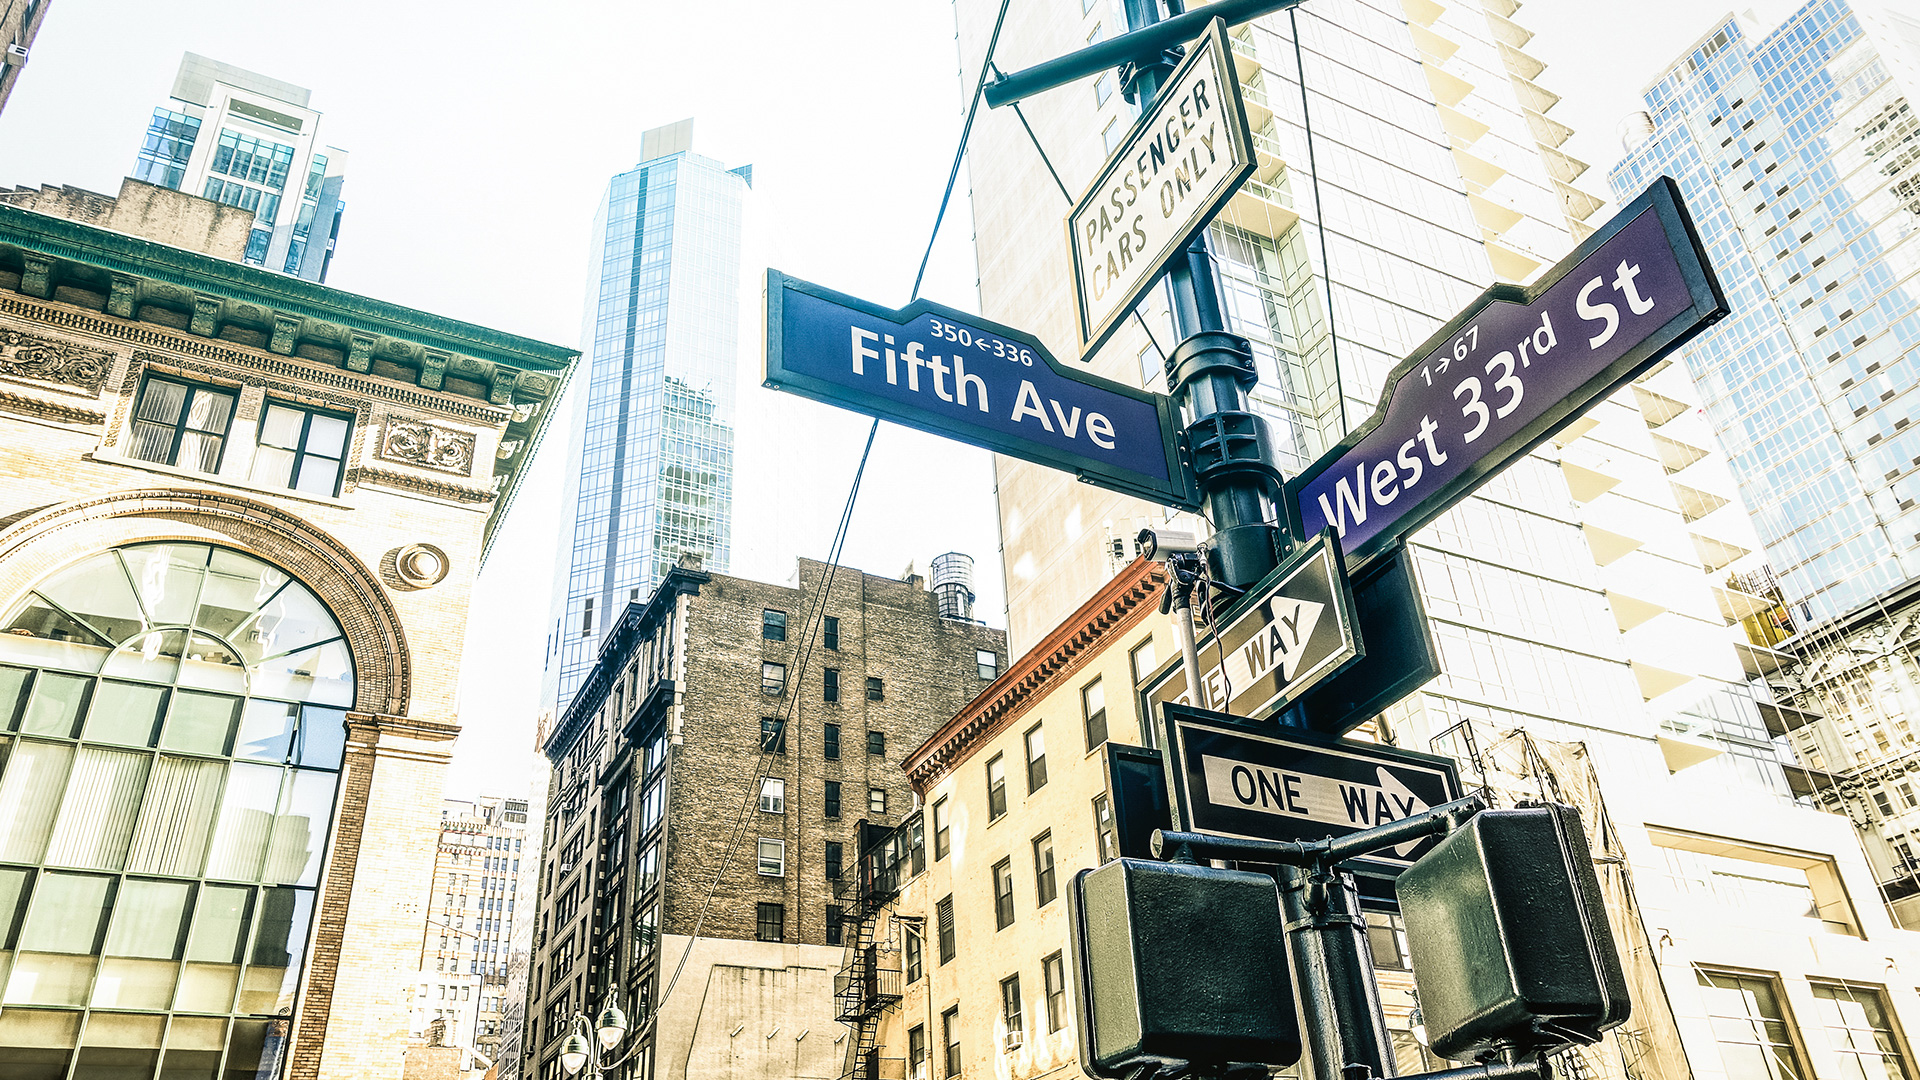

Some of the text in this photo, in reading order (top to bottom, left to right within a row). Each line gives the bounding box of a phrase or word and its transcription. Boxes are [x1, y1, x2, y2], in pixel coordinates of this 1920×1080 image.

[1086, 78, 1210, 256] PASSENGER
[1092, 121, 1215, 302] CARS ONLY
[850, 325, 1116, 450] Fifth Ave
[1317, 258, 1655, 539] West 33rd St
[1244, 604, 1300, 679] WAY
[1231, 765, 1309, 815] ONE
